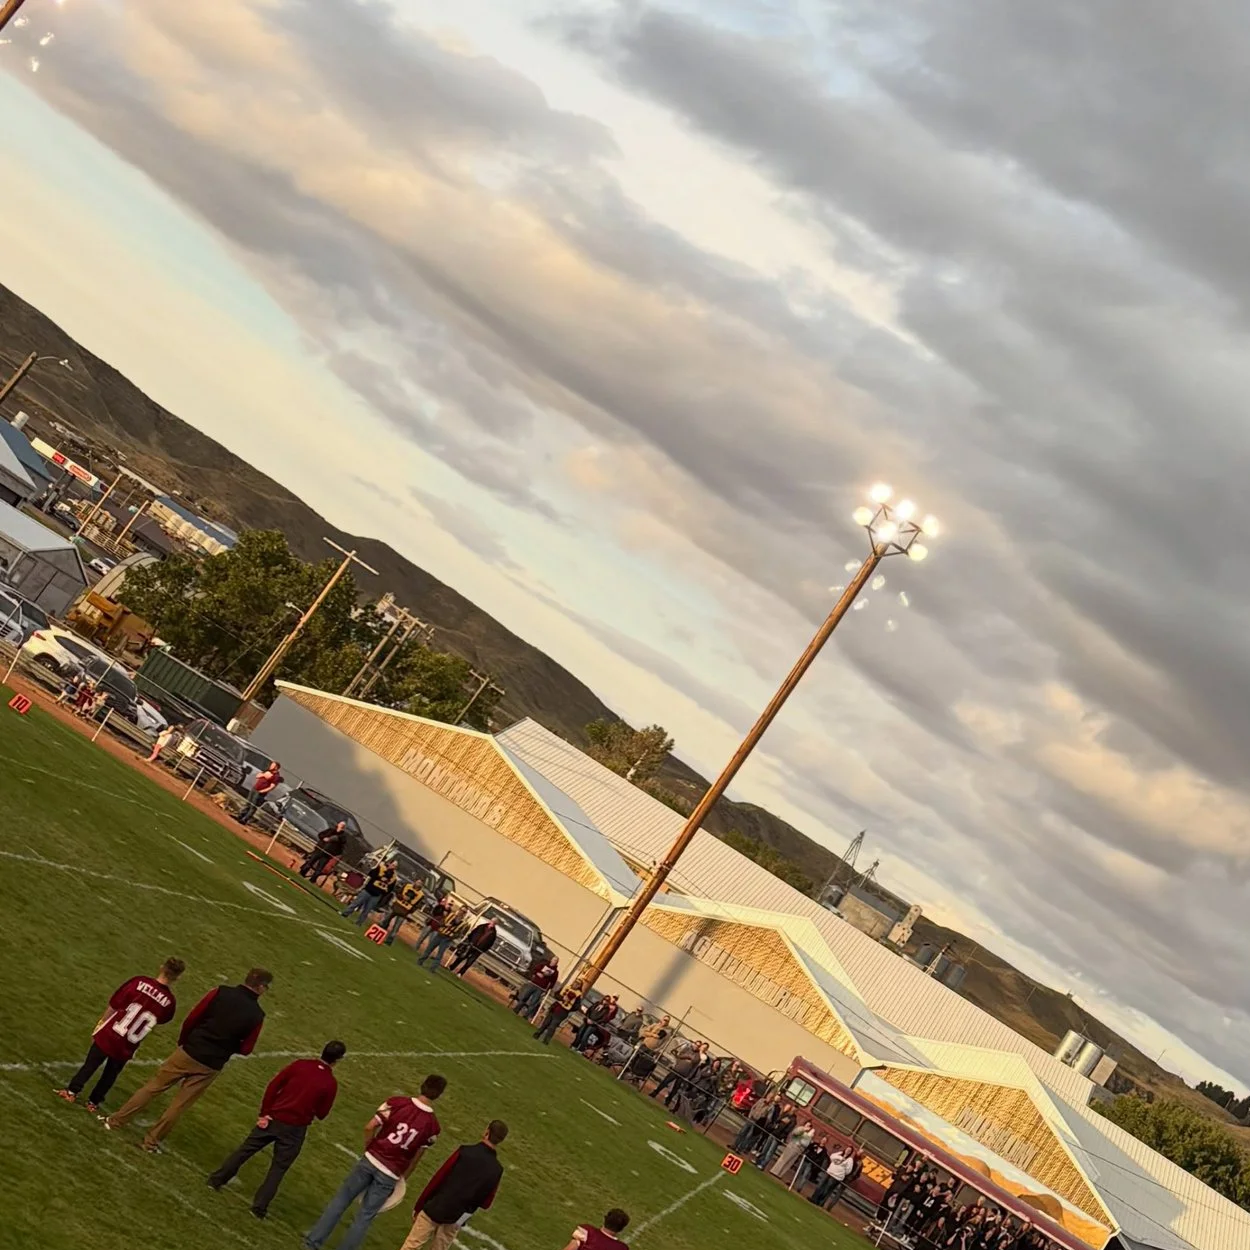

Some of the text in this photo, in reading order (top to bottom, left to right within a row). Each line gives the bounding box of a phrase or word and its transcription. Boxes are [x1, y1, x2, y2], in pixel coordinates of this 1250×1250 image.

[12, 694, 29, 713] 10
[366, 926, 385, 943] 20
[112, 1002, 157, 1044] 10
[387, 1122, 419, 1150] 31
[722, 1154, 742, 1172] 30
